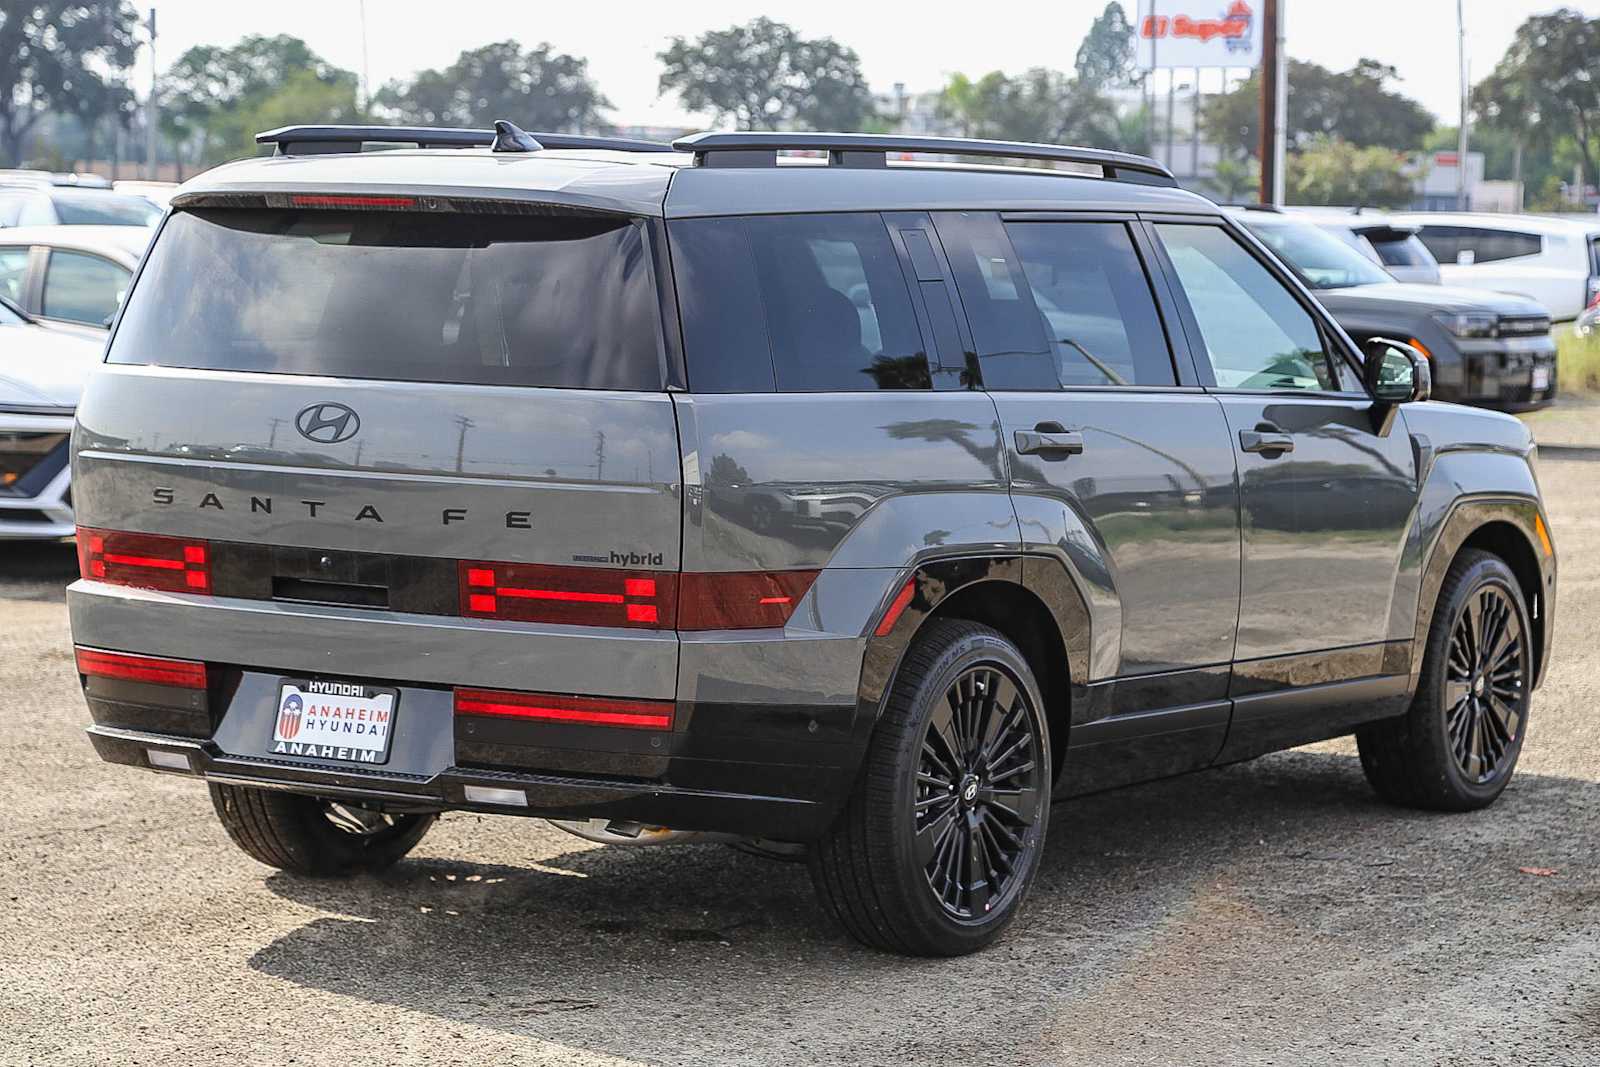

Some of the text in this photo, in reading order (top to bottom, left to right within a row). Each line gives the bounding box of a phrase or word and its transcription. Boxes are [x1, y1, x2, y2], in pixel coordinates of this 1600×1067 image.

[152, 486, 533, 529] SANTA FE
[609, 551, 664, 567] hybrid
[308, 681, 364, 697] HYUNDAI
[307, 704, 388, 723] ANAHEIM
[306, 718, 386, 737] HYUNDAI
[274, 742, 376, 763] ANAHEIM
